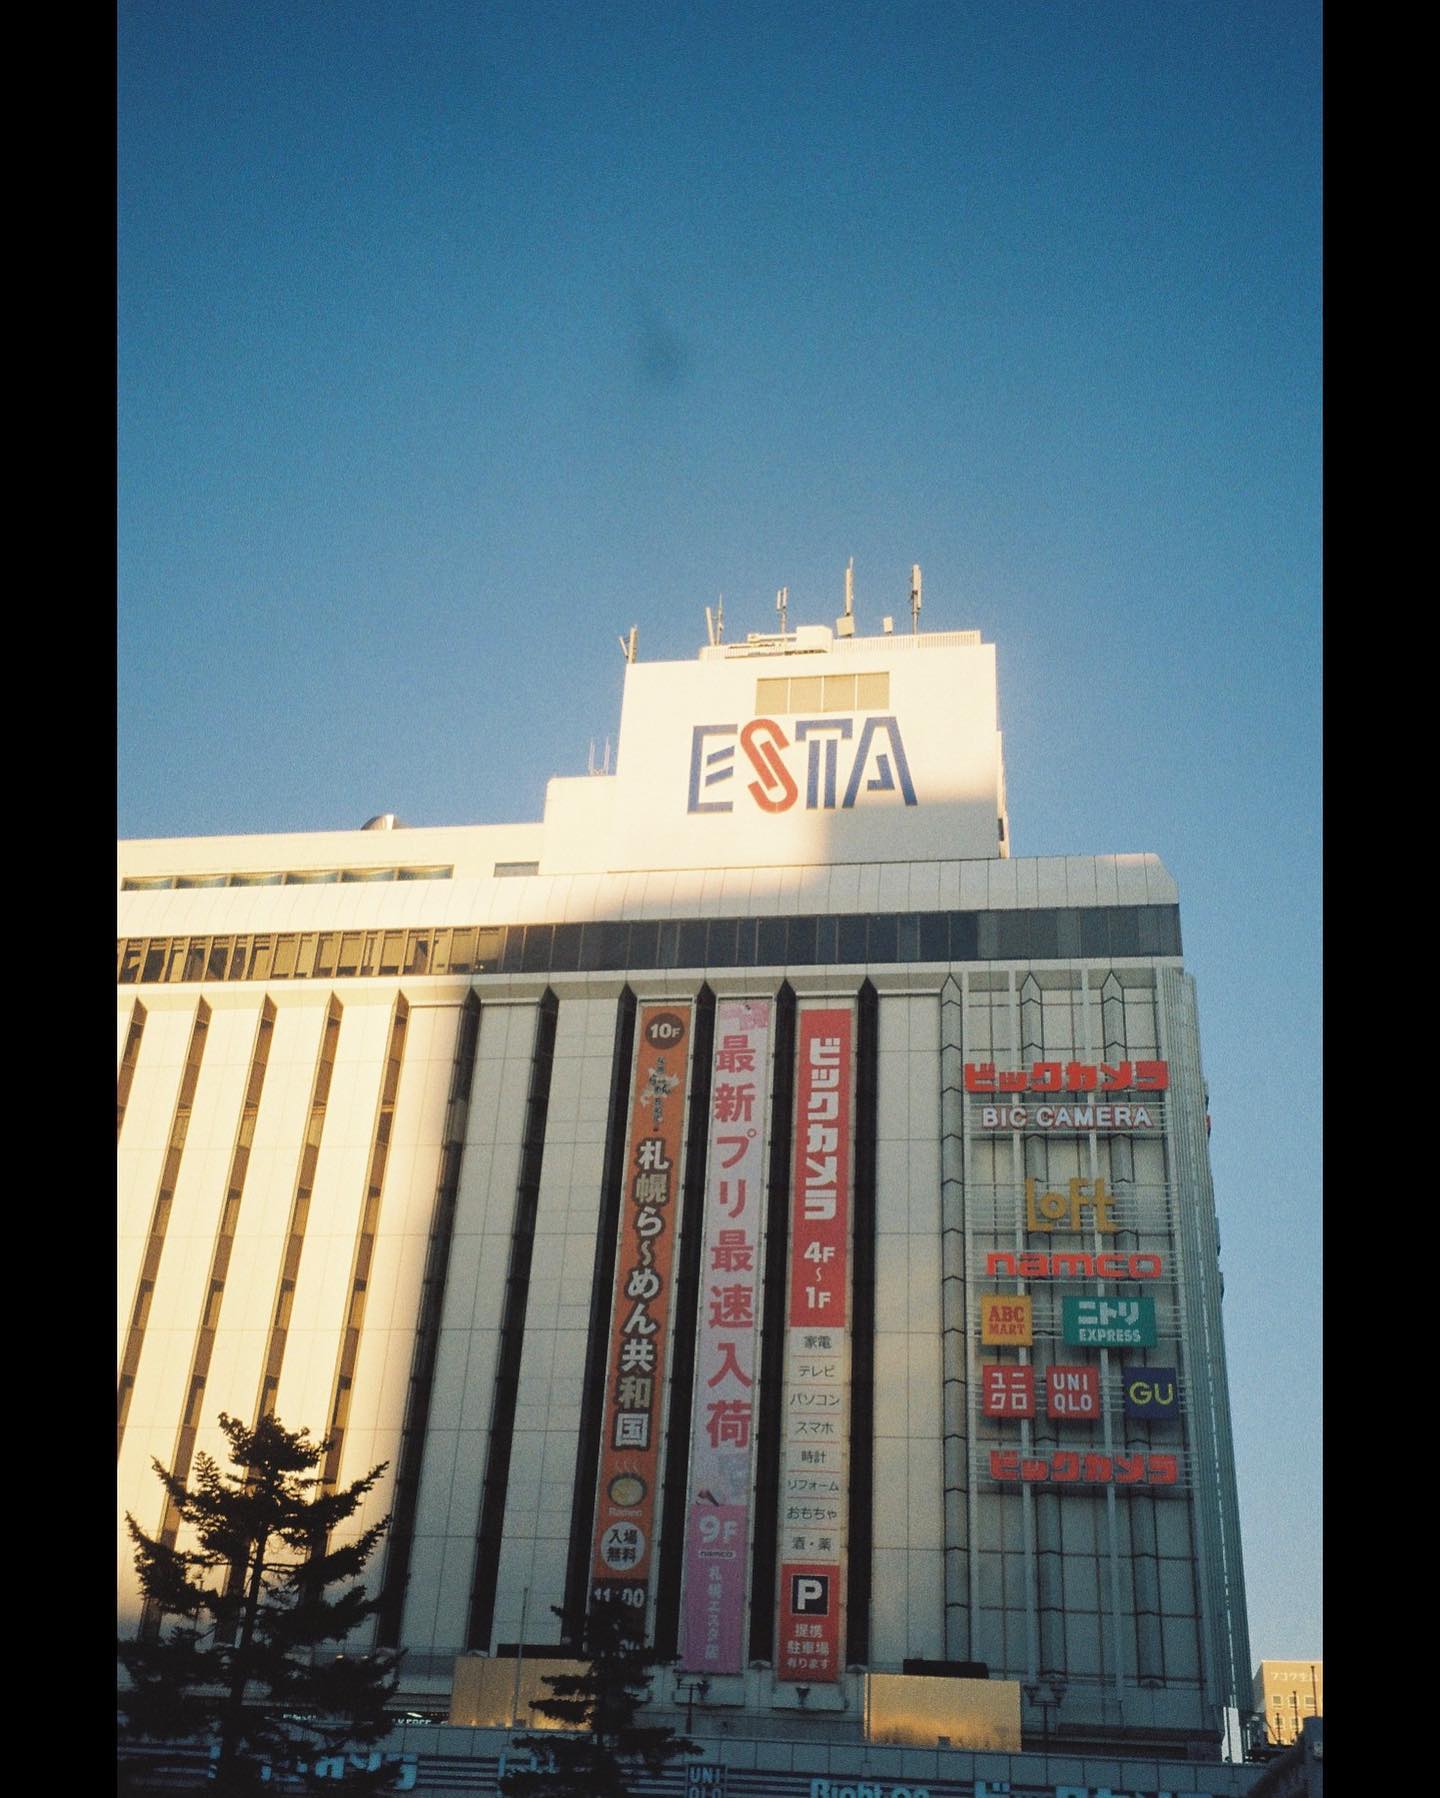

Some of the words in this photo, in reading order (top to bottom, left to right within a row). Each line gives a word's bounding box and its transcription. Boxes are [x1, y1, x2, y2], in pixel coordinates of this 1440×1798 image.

[687, 716, 918, 814] ESTA
[650, 1023, 681, 1039] 10F
[965, 1060, 1169, 1093] ビックカメラ
[982, 1107, 1027, 1128] BIC
[1036, 1105, 1153, 1128] CAMERA
[804, 1037, 841, 1220] ビックカメラ
[706, 1034, 757, 1448] 最新プリ最速入荷
[803, 1241, 836, 1263] 4F
[986, 1252, 1162, 1279] namco
[805, 1286, 832, 1309] 1F
[988, 1305, 1025, 1323] ABC
[1078, 1300, 1140, 1326] ニトリ
[989, 1323, 1025, 1336] MART
[1079, 1328, 1141, 1343] EXPRESS
[803, 1335, 832, 1350] 家電
[799, 1364, 835, 1378] テレビ
[790, 1392, 841, 1407] パソコン
[1129, 1381, 1174, 1405] GU
[795, 1421, 834, 1435] スマホ
[801, 1450, 827, 1464] 時計
[990, 1450, 1178, 1485] ビックカメラ
[787, 1478, 840, 1492] リフォーム
[786, 1506, 838, 1521] おもちゃ
[608, 1528, 638, 1545] 入場
[698, 1514, 738, 1543] 9F
[607, 1546, 637, 1563] 無料
[797, 1578, 823, 1611] P
